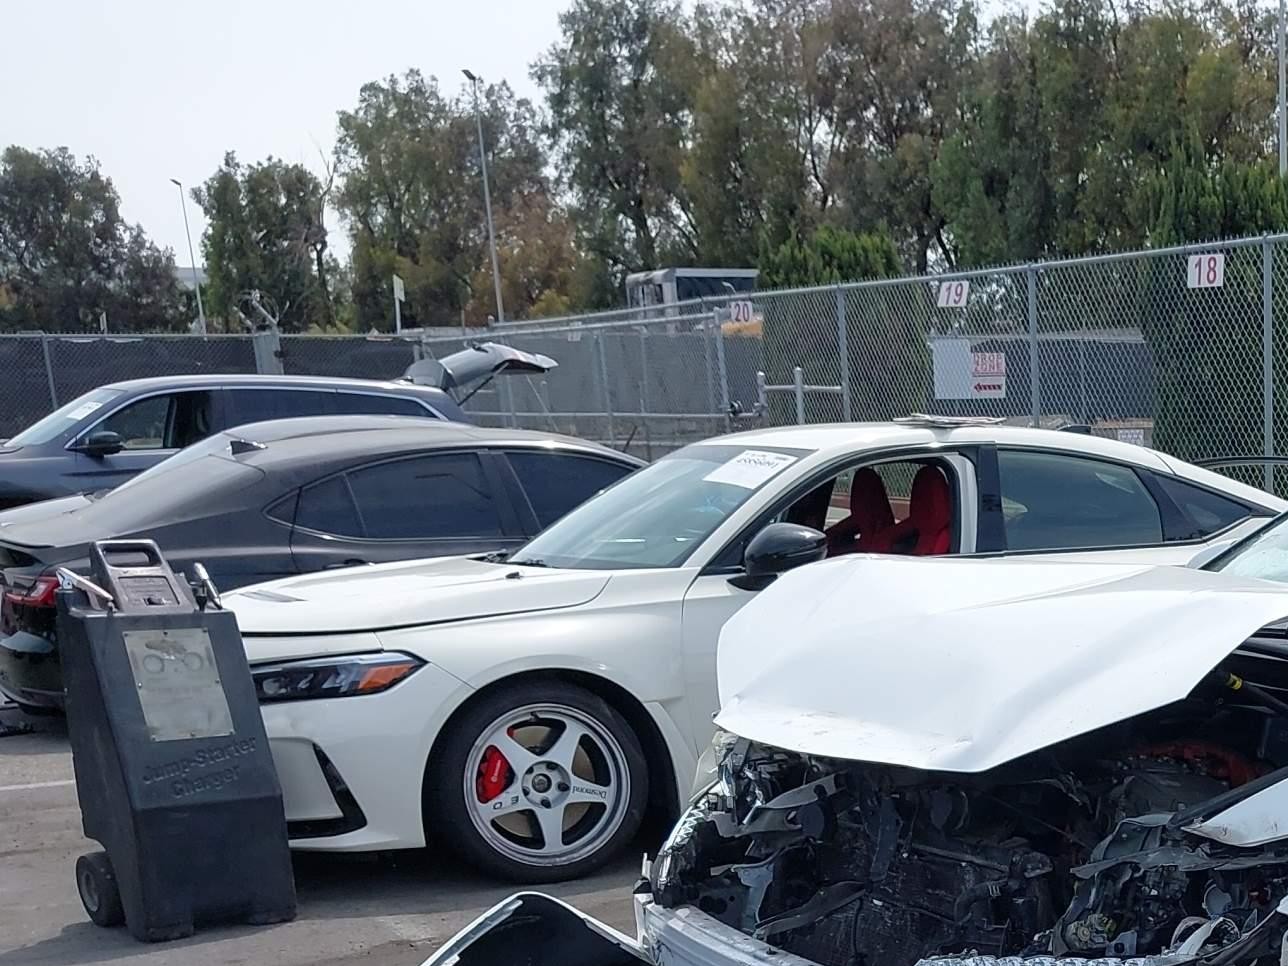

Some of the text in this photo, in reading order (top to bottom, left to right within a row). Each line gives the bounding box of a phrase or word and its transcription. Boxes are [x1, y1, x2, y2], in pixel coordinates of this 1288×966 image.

[1194, 256, 1217, 286] 18
[945, 282, 963, 305] 19
[734, 303, 749, 322] 20
